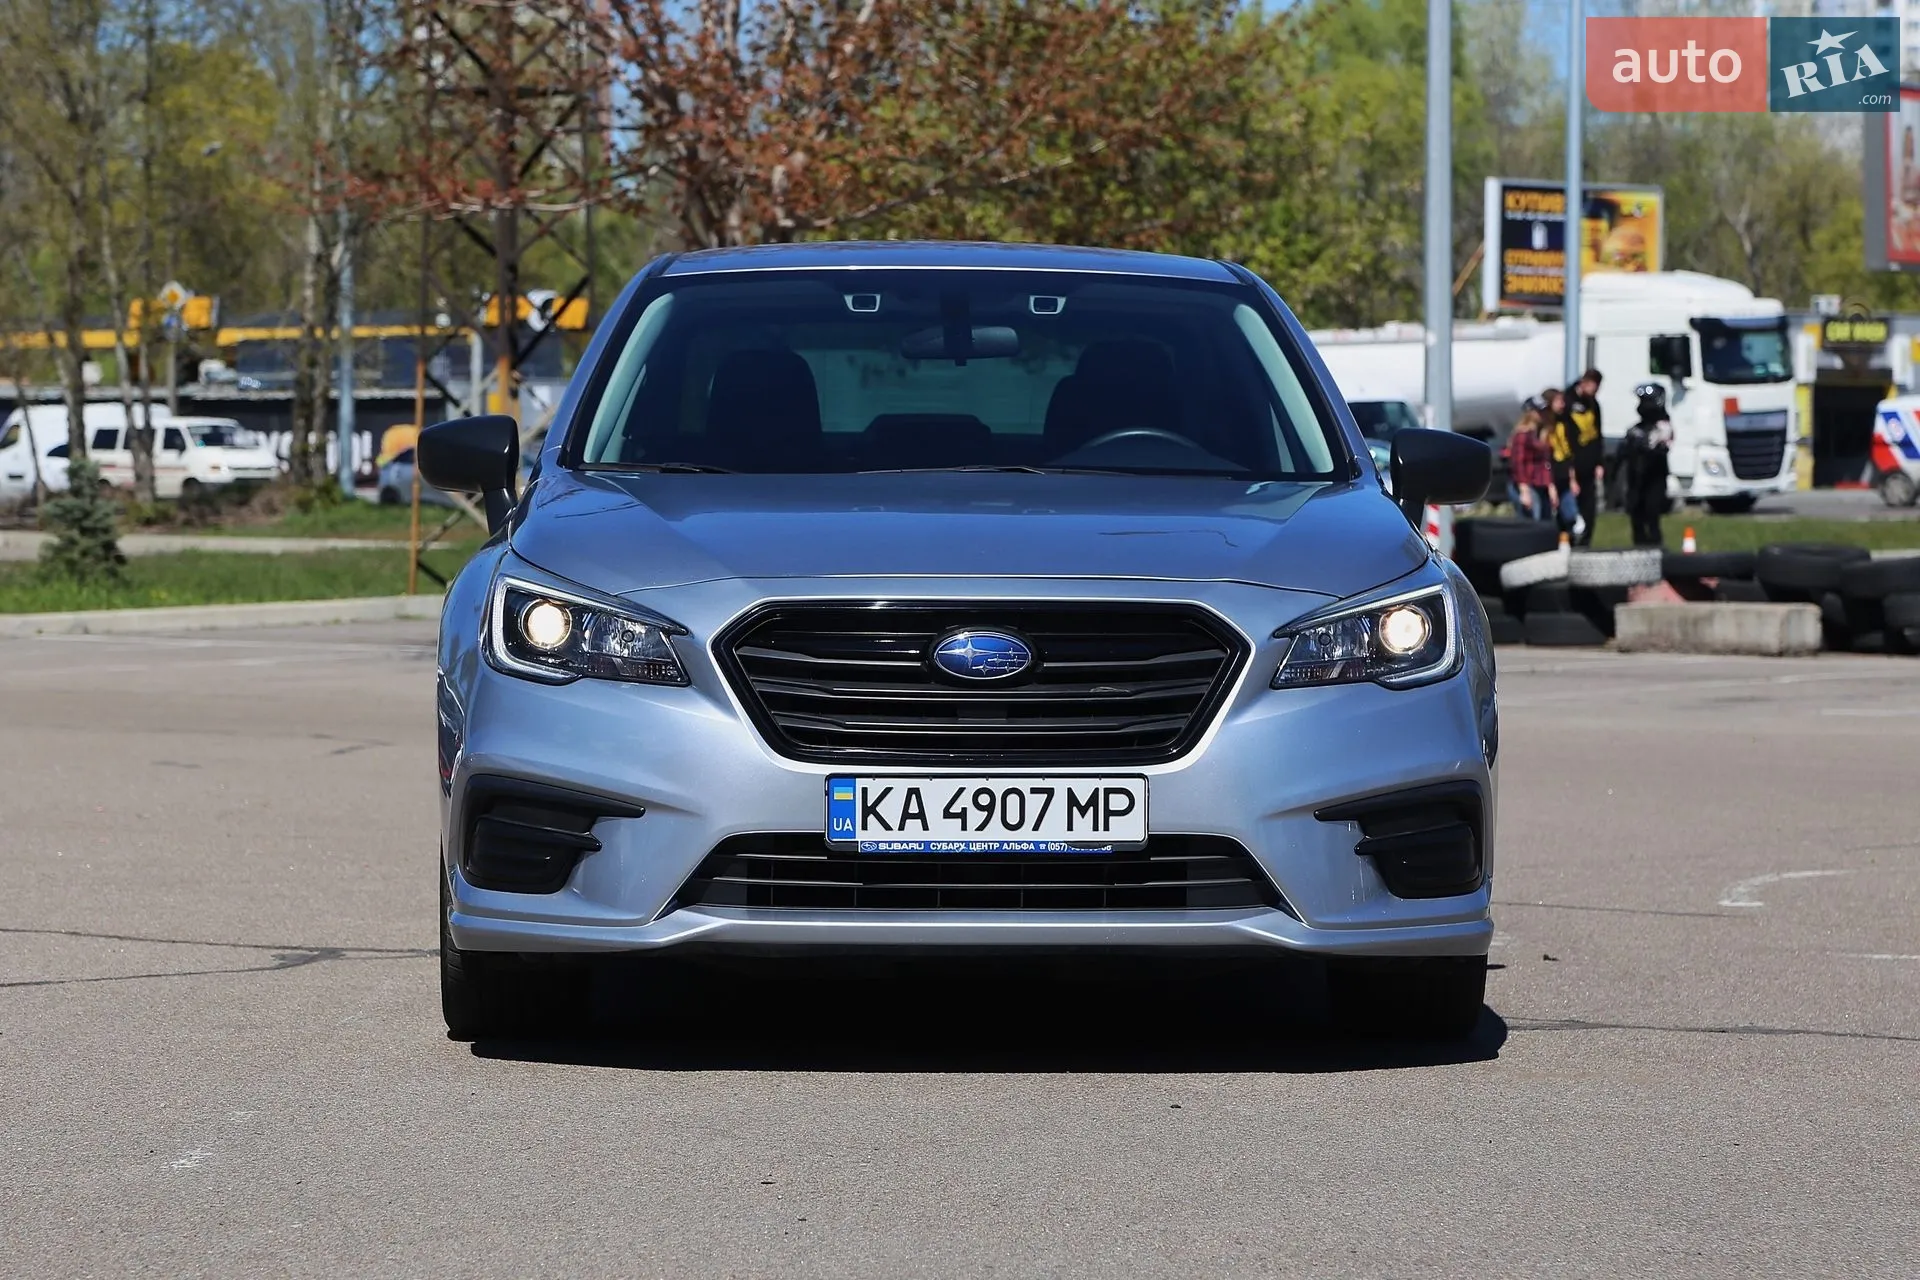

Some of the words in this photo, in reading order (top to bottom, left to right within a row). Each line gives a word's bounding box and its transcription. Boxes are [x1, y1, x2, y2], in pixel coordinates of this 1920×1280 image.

[860, 786, 930, 832] KA
[942, 786, 1056, 832] 4907
[1065, 786, 1136, 832] MP
[833, 818, 854, 832] UA
[878, 842, 924, 850] SUBARU
[930, 842, 966, 851] СУБАРУ
[969, 842, 1000, 852] ЦЕНТР
[1002, 842, 1035, 851] АЛЬФА
[1047, 841, 1068, 852] (057)
